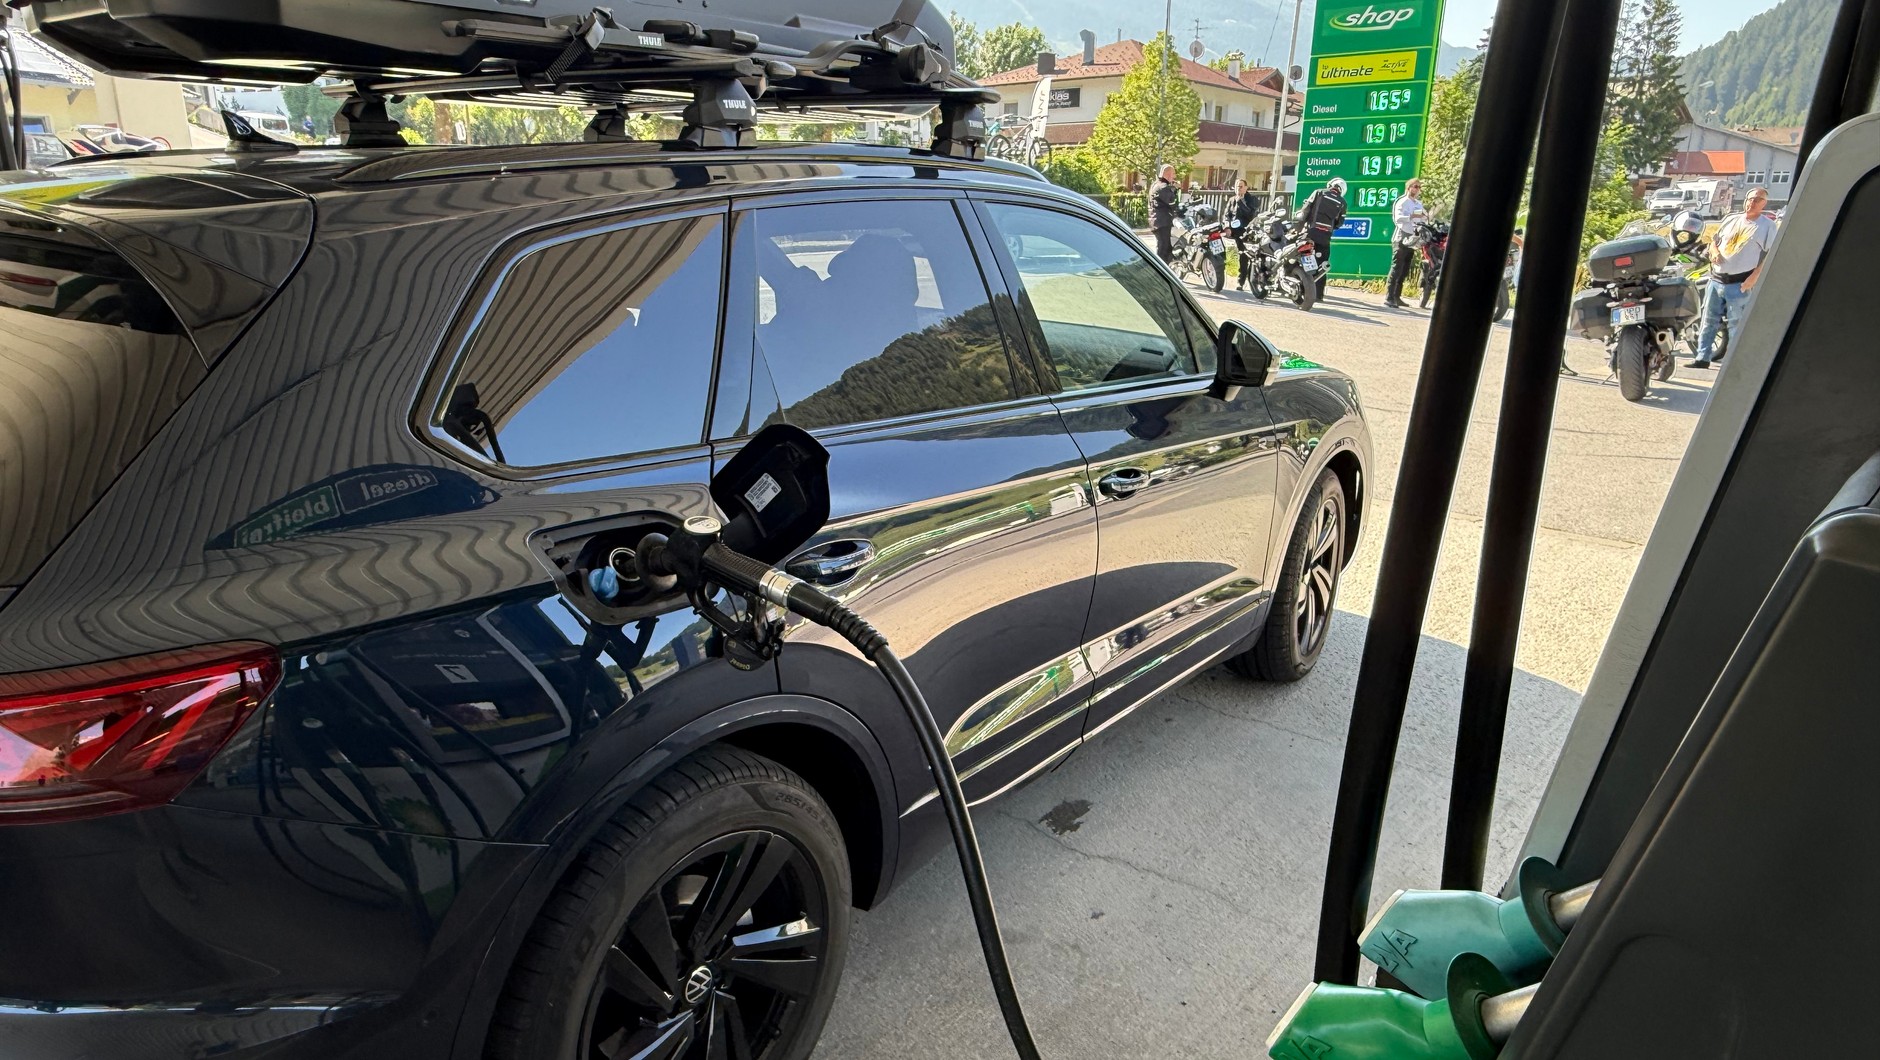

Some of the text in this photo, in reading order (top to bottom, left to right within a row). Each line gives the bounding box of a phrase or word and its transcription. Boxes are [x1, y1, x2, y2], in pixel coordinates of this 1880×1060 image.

[1345, 4, 1415, 30] shop
[638, 35, 662, 47] THULE
[1321, 65, 1374, 79] ultimate
[723, 99, 747, 110] THULE
[1312, 104, 1338, 114] Diesel
[1310, 126, 1345, 135] Ultimate
[1309, 136, 1334, 145] Diesel
[1306, 157, 1341, 166] Ultimate
[1305, 167, 1330, 178] Super
